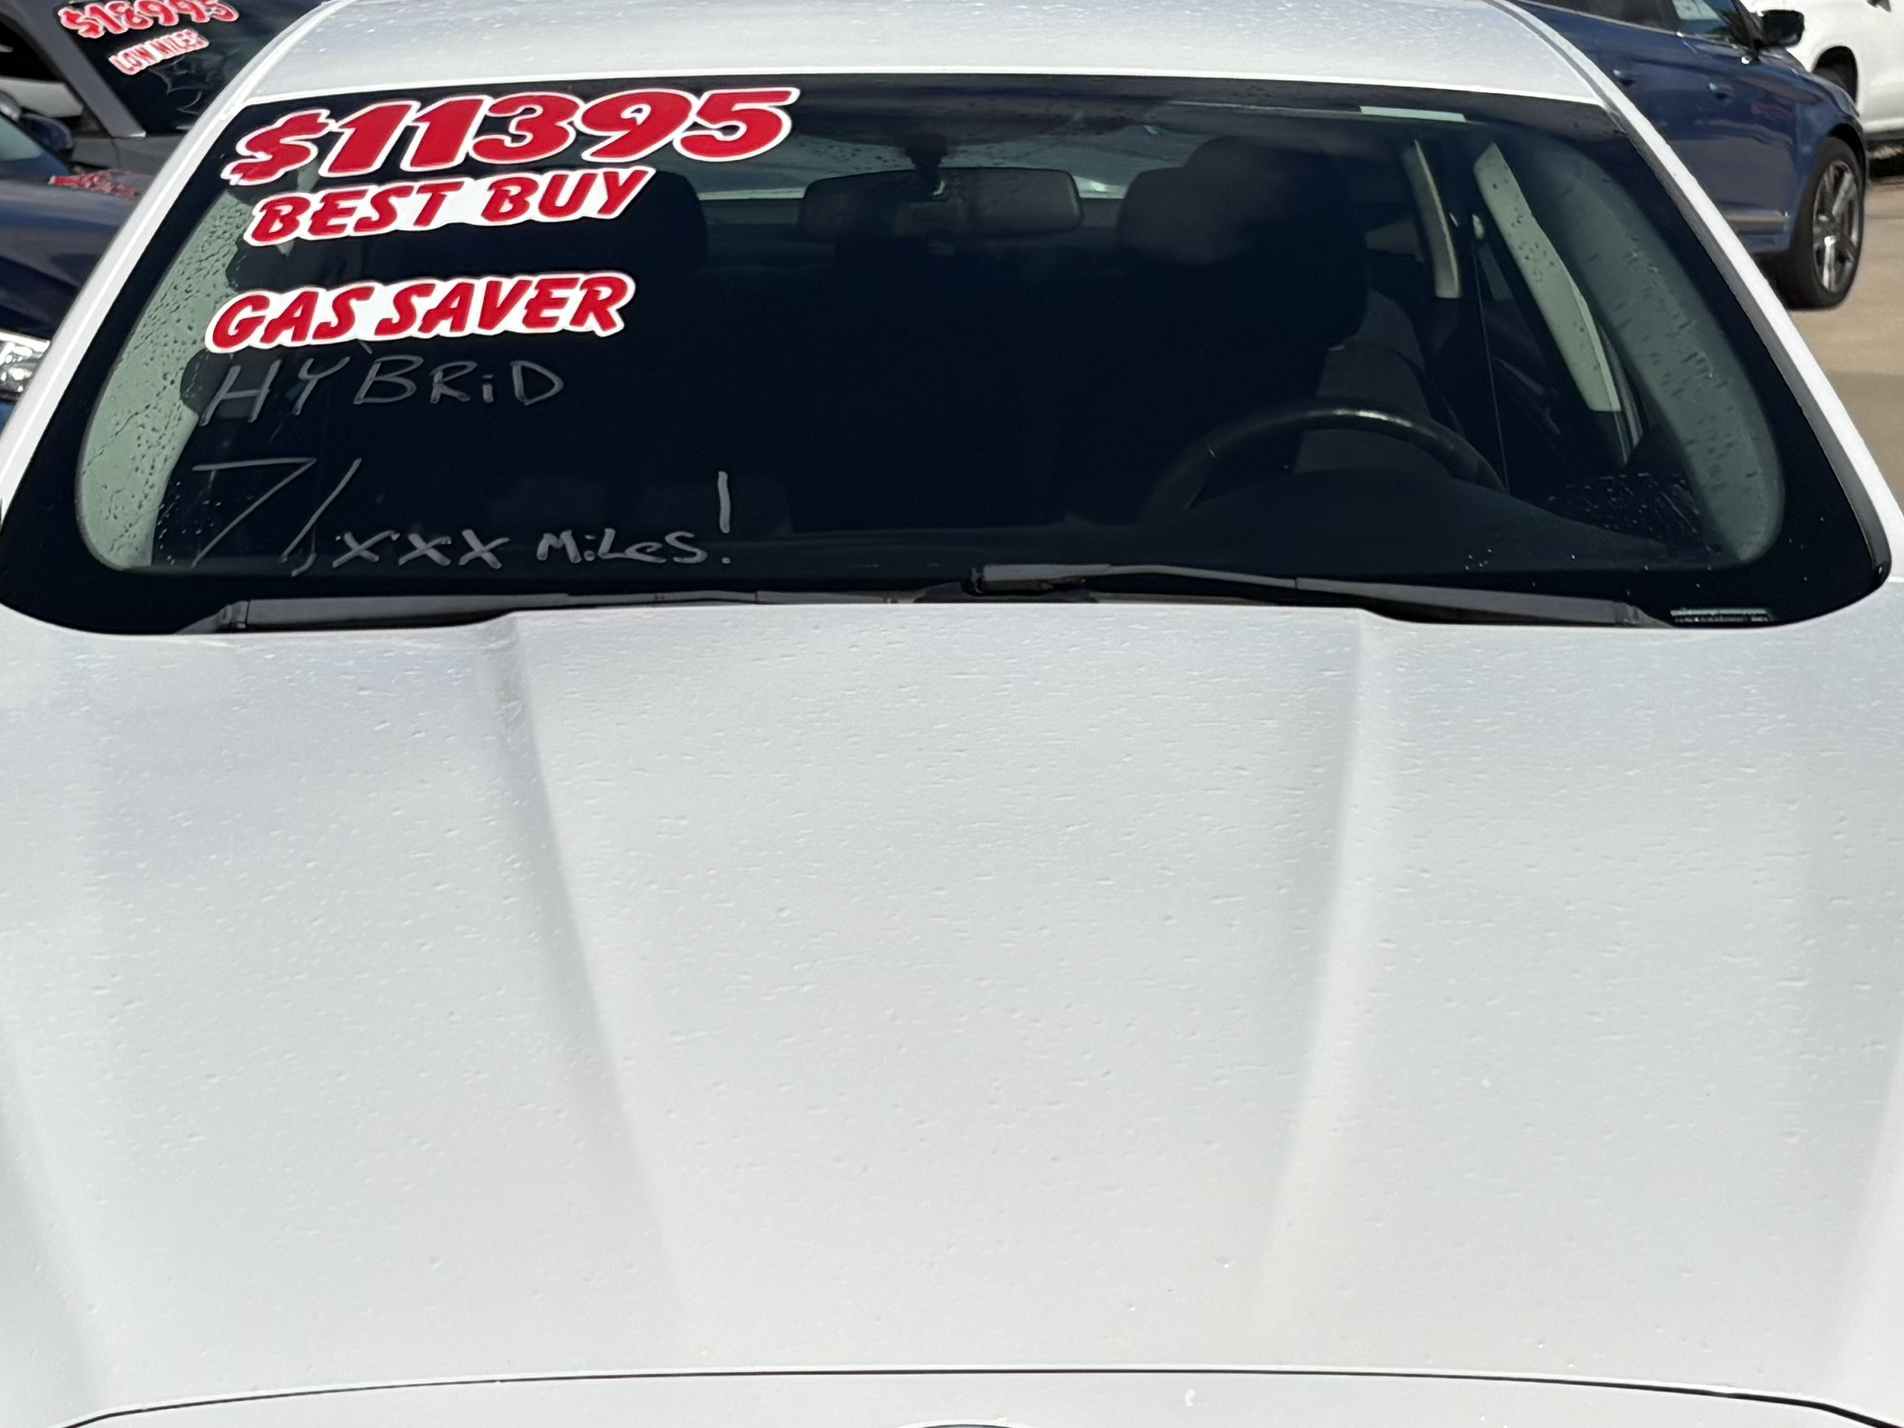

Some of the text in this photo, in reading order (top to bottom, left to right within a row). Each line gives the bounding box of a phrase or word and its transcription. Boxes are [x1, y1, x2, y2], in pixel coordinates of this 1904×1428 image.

[111, 31, 206, 72] LOW MILES
[222, 88, 799, 186] $11395
[249, 168, 654, 245] BEST BUY
[208, 274, 633, 352] GAS SAVER
